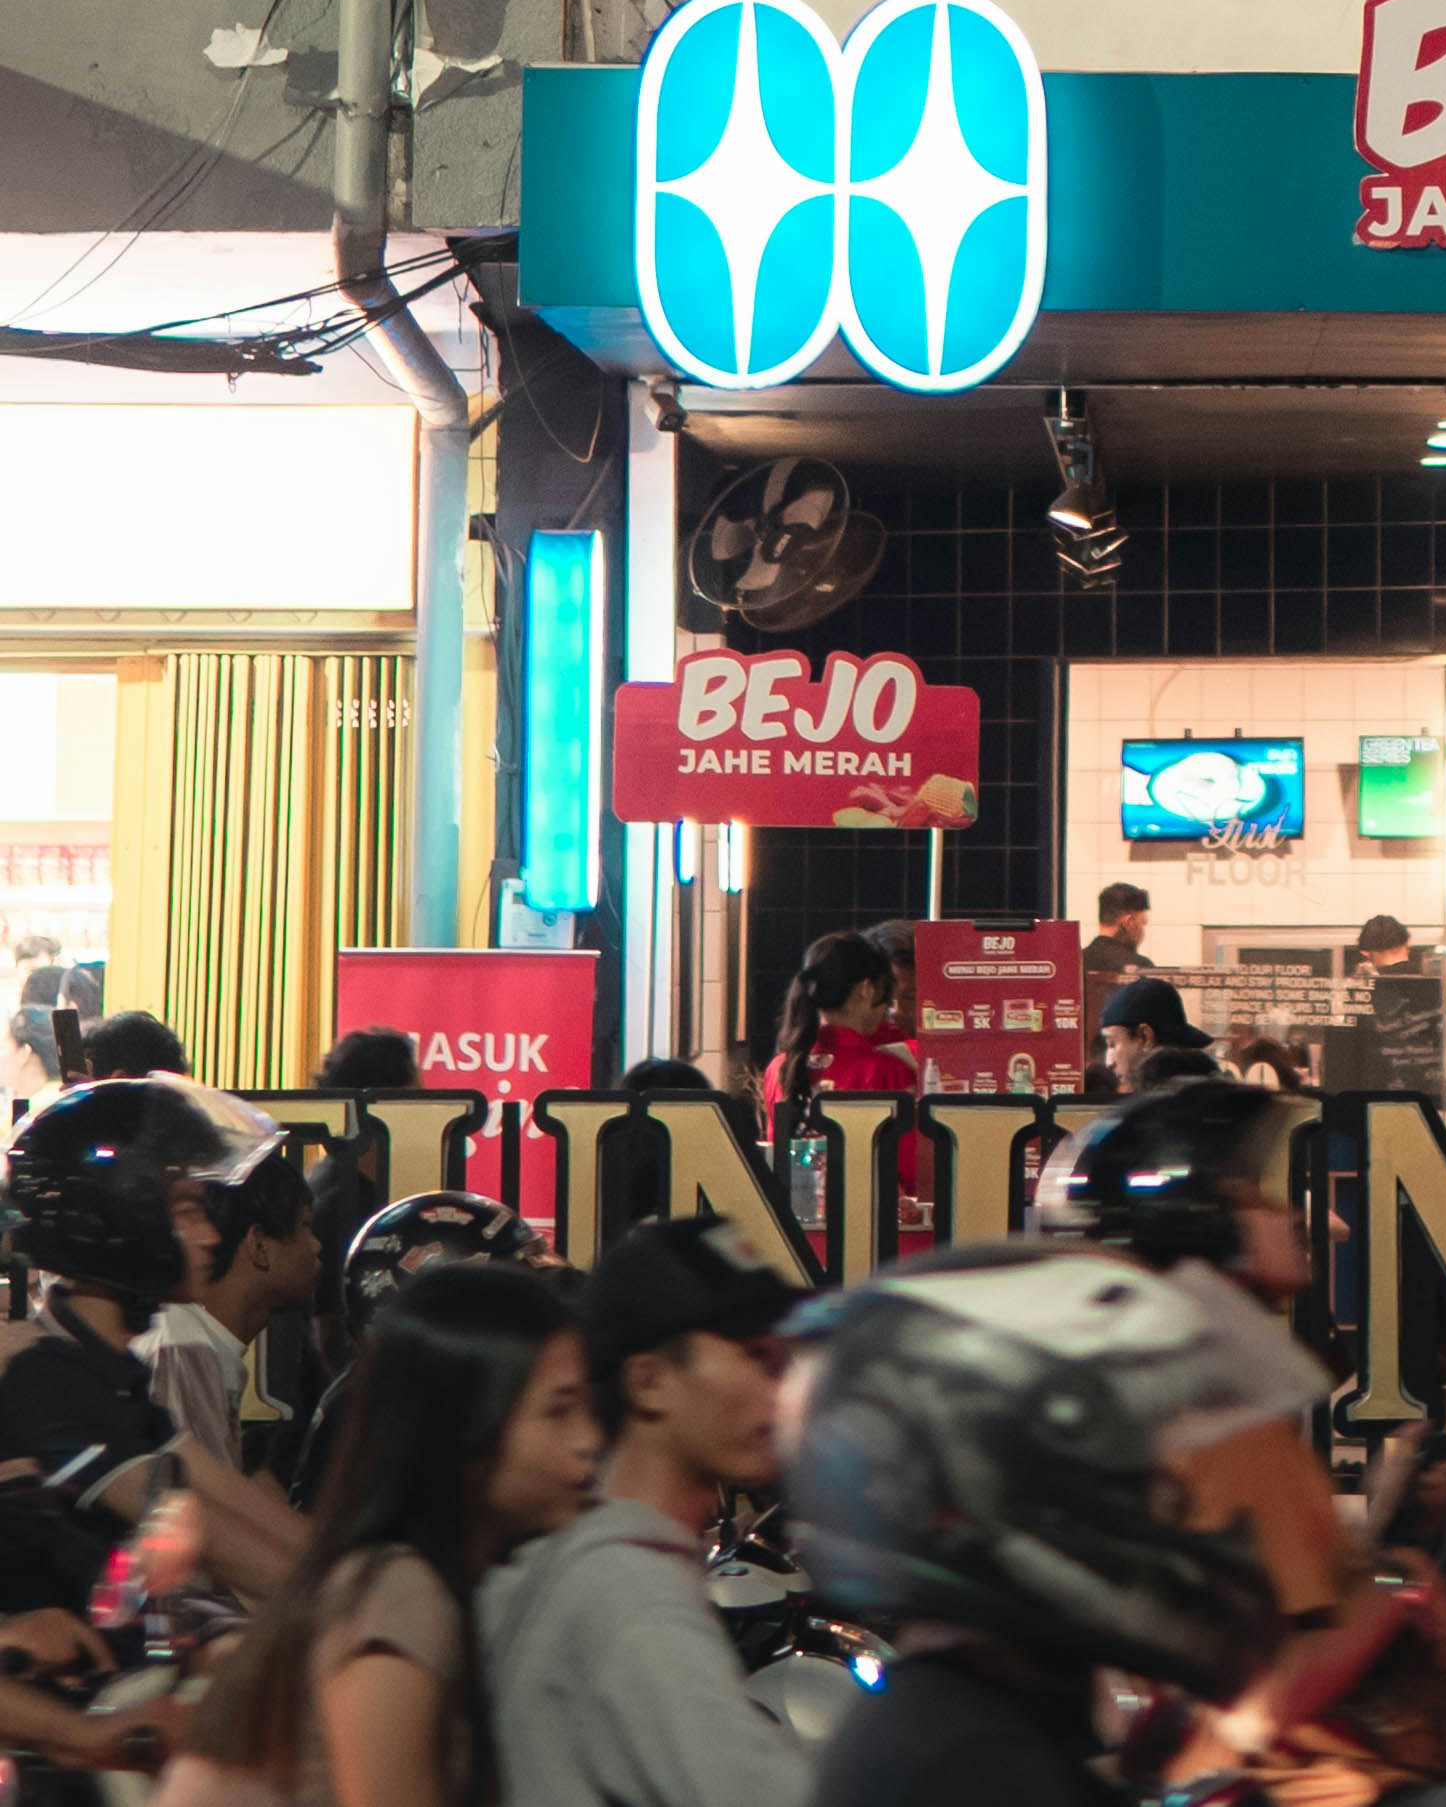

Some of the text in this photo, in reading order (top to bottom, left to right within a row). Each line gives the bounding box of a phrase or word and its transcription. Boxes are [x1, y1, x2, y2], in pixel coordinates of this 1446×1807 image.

[677, 656, 917, 744] BEJO
[677, 748, 913, 777] JAHE MERAH
[1186, 852, 1307, 889] FLOOR
[982, 936, 1016, 950] BEJO
[410, 1032, 549, 1073] ASUK
